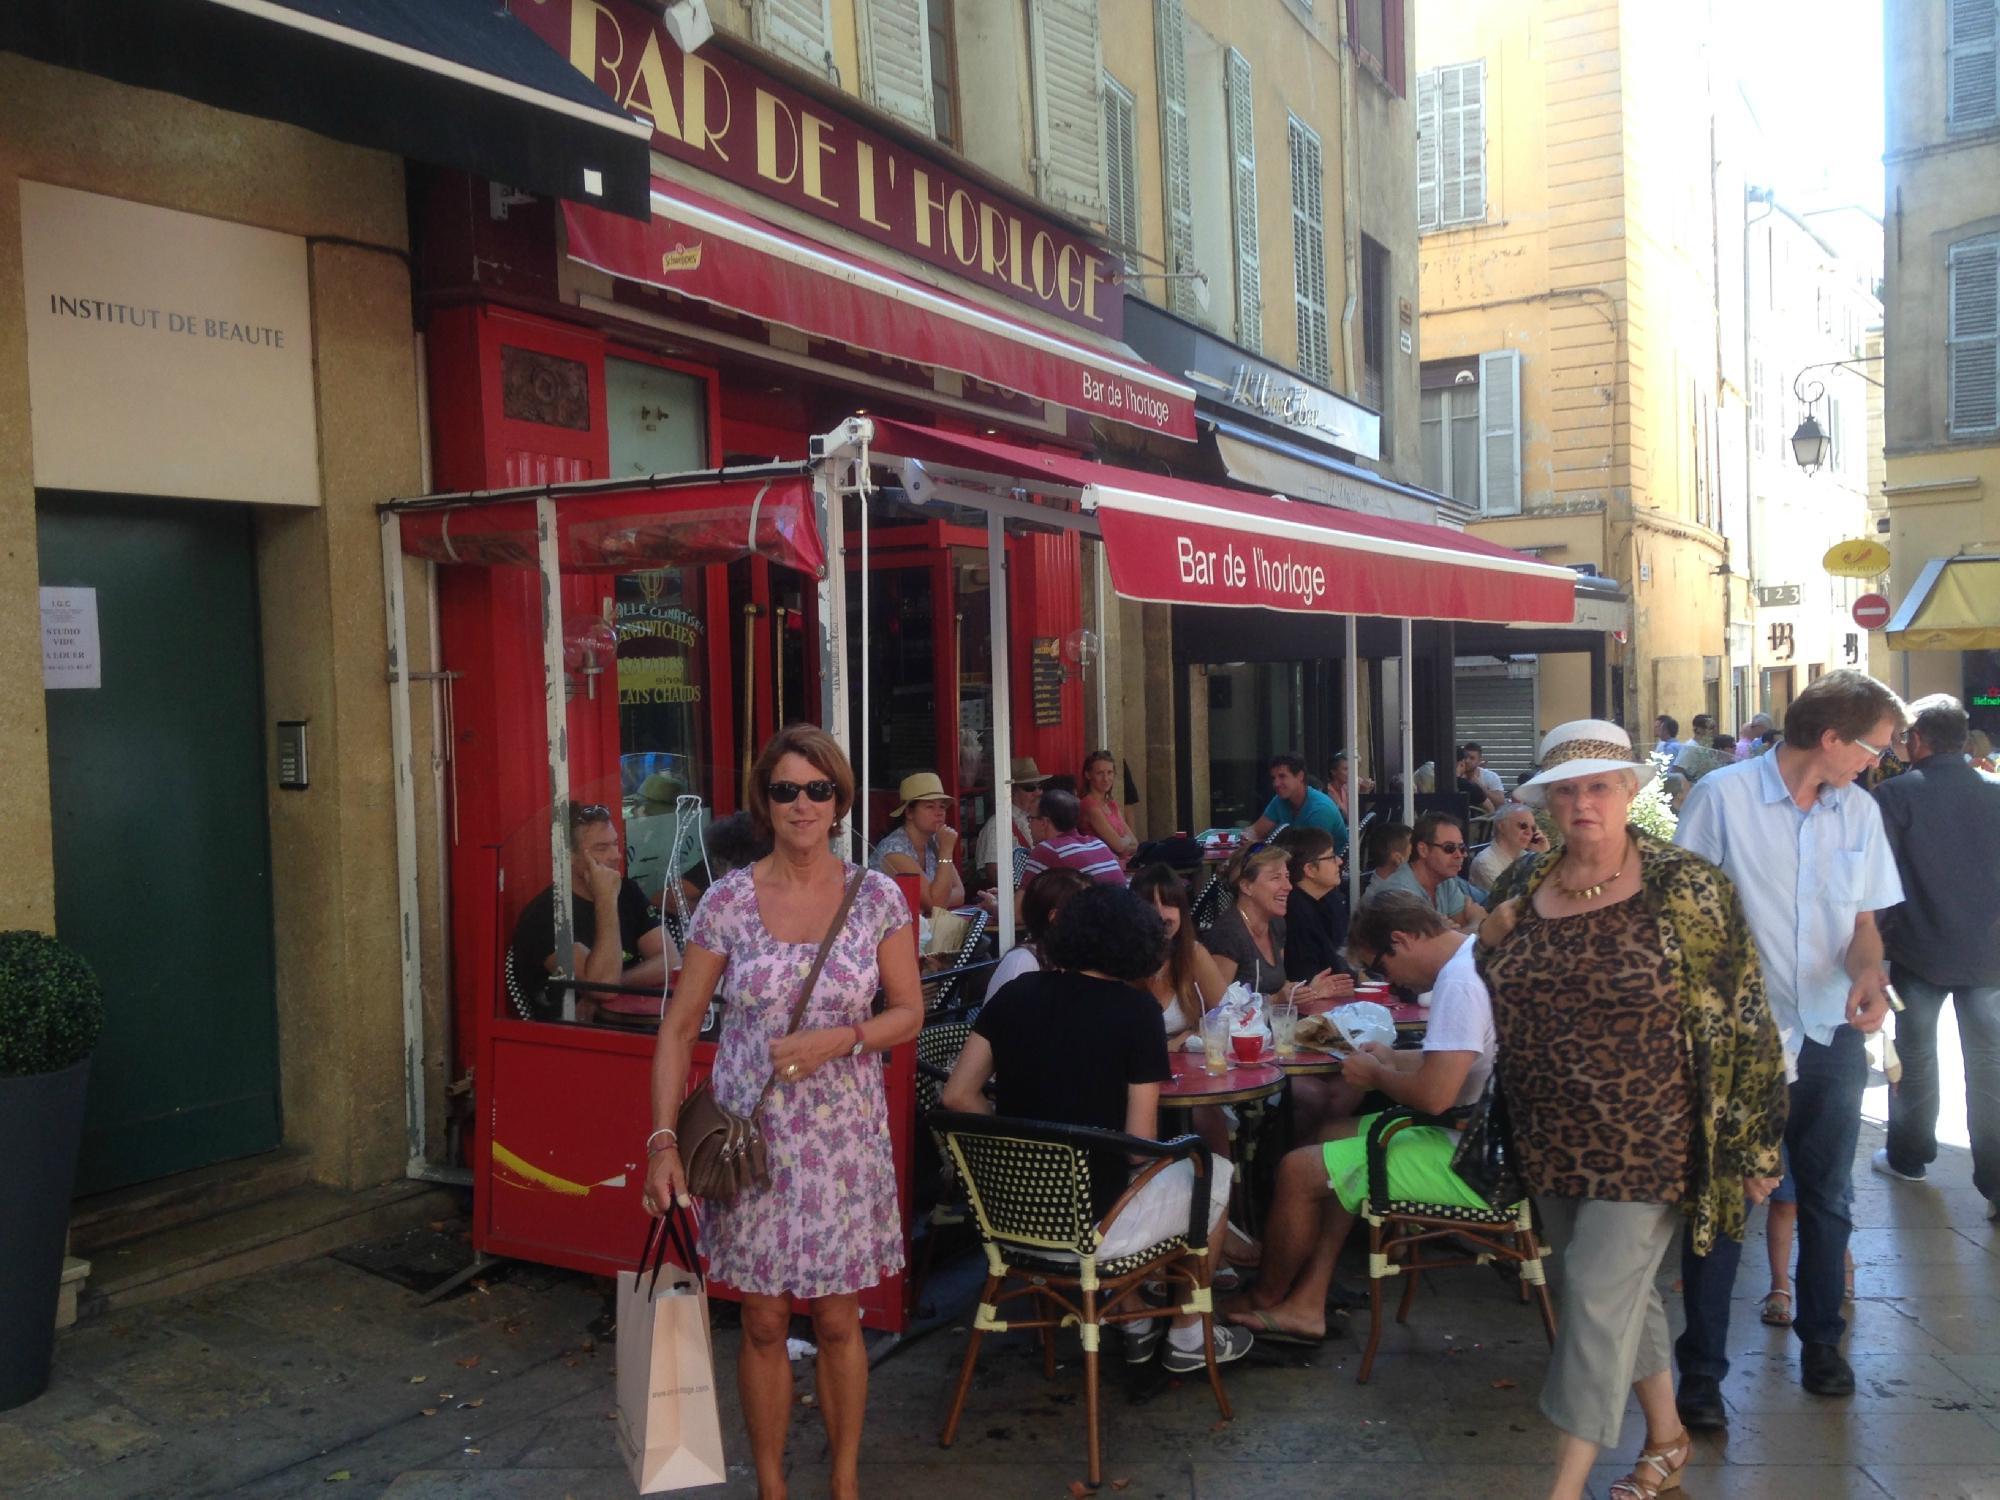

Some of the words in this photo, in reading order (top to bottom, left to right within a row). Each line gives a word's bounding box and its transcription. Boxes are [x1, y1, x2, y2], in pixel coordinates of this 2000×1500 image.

[571, 0, 729, 161] BAR
[756, 87, 839, 208] DE
[51, 294, 160, 329] INSTITUT
[169, 312, 197, 336] DE
[205, 318, 284, 349] BEAUTE
[1082, 371, 1104, 402] Bar
[1108, 380, 1122, 408] de
[1126, 384, 1169, 426] l'horloge
[1177, 536, 1216, 585] Bar
[1223, 543, 1247, 588] de
[1253, 547, 1326, 606] l'horloge
[616, 603, 646, 619] ALLE
[619, 620, 696, 647] ANDWICHES
[619, 688, 650, 704] LATS
[654, 685, 701, 703] CHAUDS
